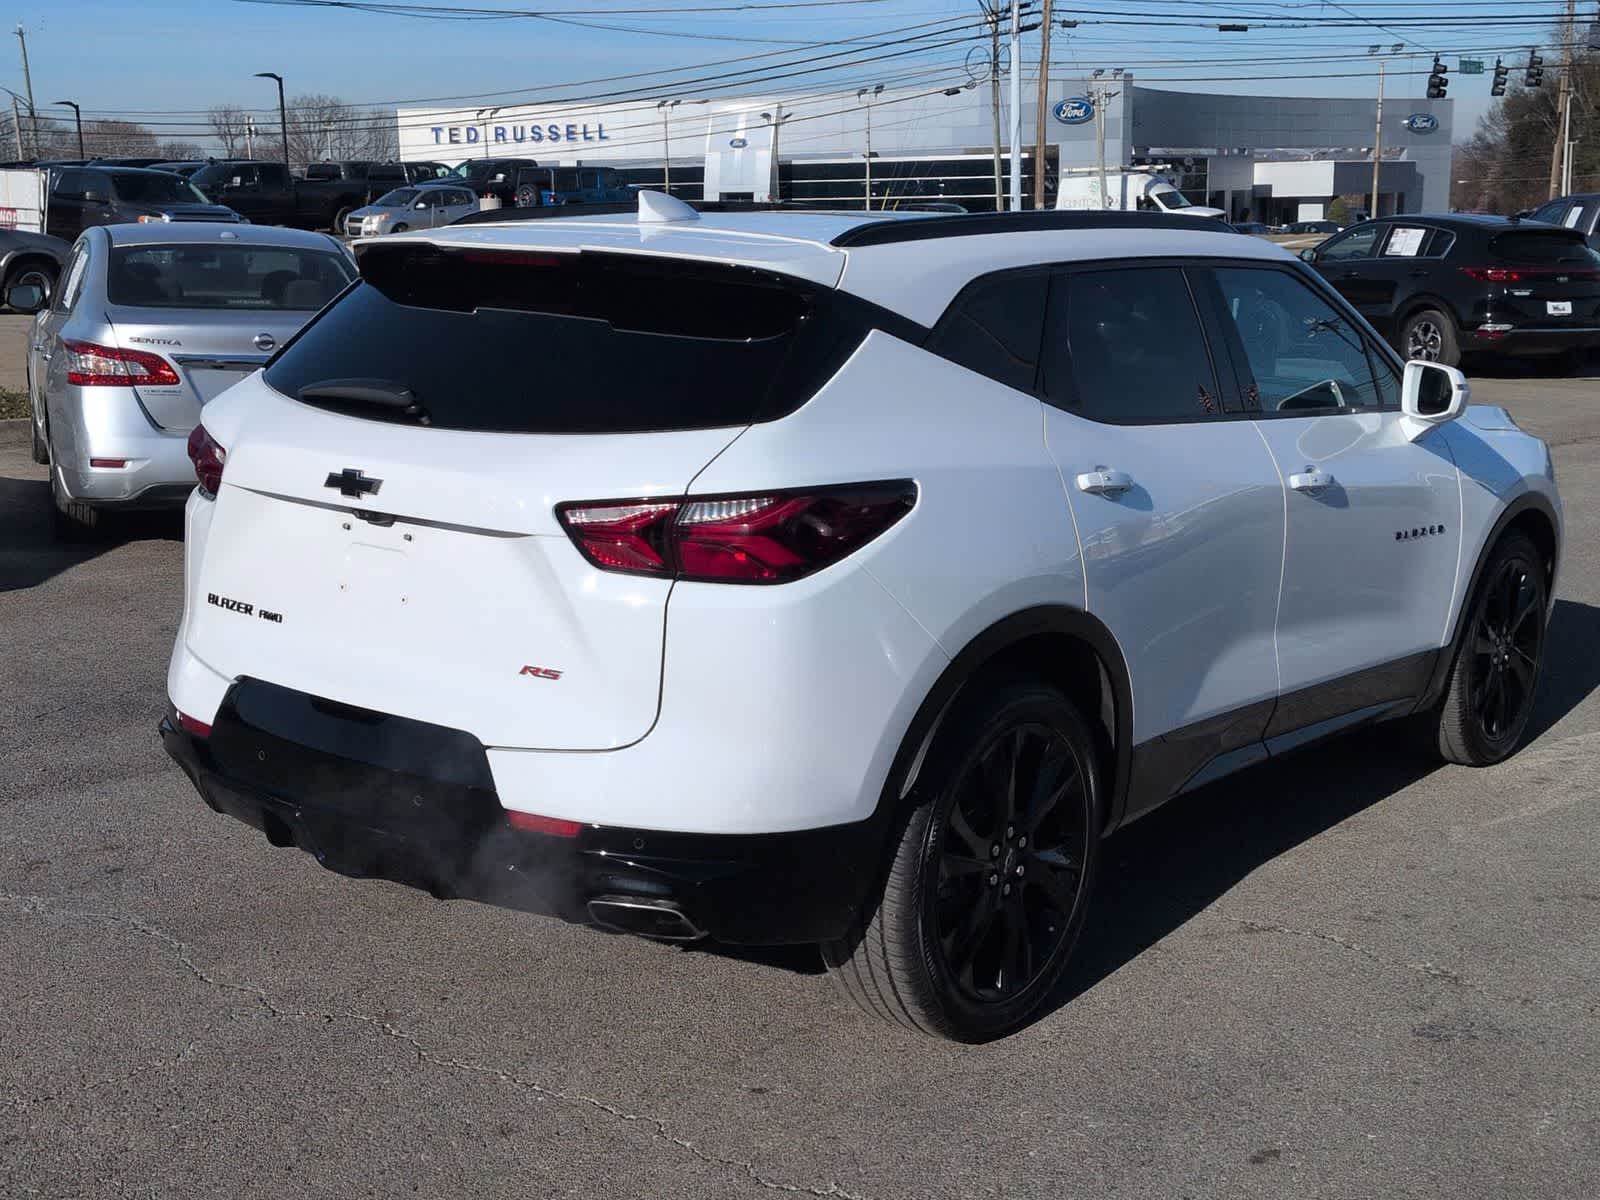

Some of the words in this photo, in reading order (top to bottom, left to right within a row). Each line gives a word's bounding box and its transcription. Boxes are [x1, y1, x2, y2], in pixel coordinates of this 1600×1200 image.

[431, 127, 480, 144] TED
[494, 123, 609, 144] RUSSELL
[129, 336, 182, 346] SENTRA
[1395, 524, 1447, 541] BLAZER
[207, 592, 254, 616] BLAZER
[258, 609, 283, 624] AWD
[518, 665, 564, 681] RS
